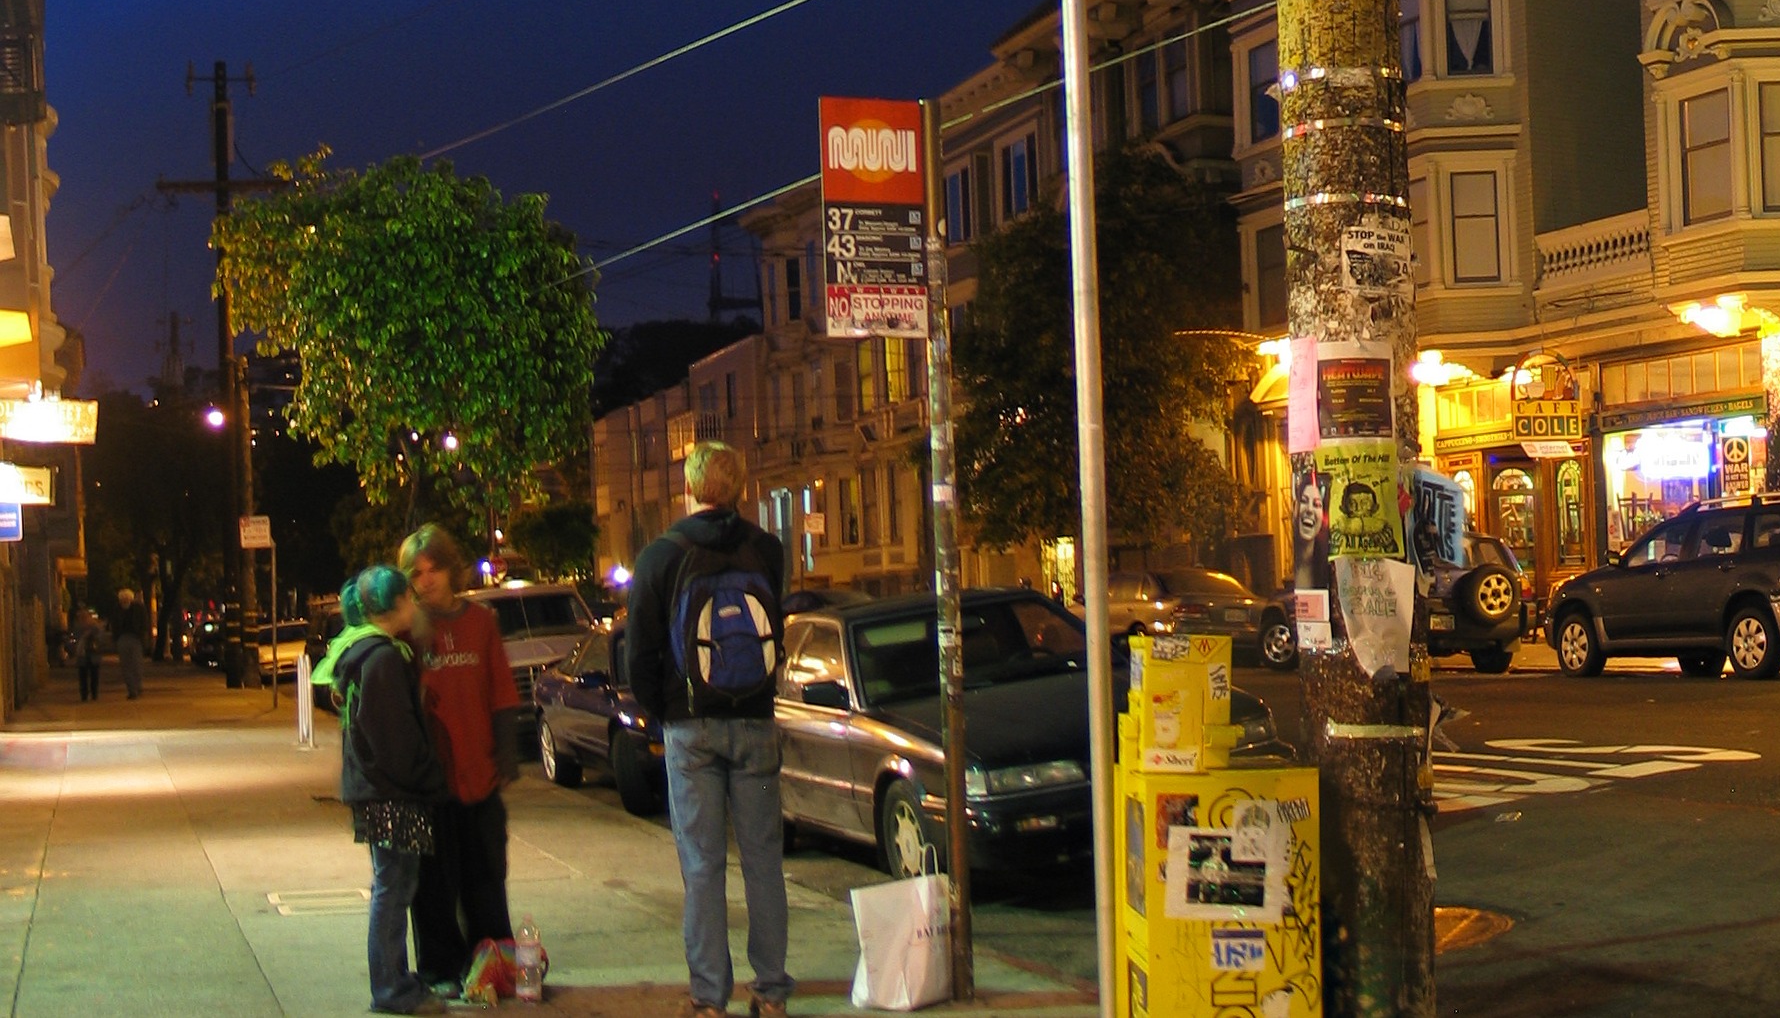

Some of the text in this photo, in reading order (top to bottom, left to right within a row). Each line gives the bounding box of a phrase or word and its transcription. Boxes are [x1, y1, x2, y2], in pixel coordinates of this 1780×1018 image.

[827, 125, 917, 173] MUNI
[827, 207, 854, 232] 37
[1347, 230, 1375, 239] STOP
[827, 234, 857, 259] 43
[1377, 242, 1395, 253] IRAQ
[829, 295, 925, 318] NO STOPPING
[1516, 402, 1579, 415] CAFE
[1728, 400, 1754, 411] BAGELS
[1517, 417, 1578, 435] COLE
[1324, 454, 1391, 466] Bottom Of The Hill
[1724, 462, 1749, 473] WAR
